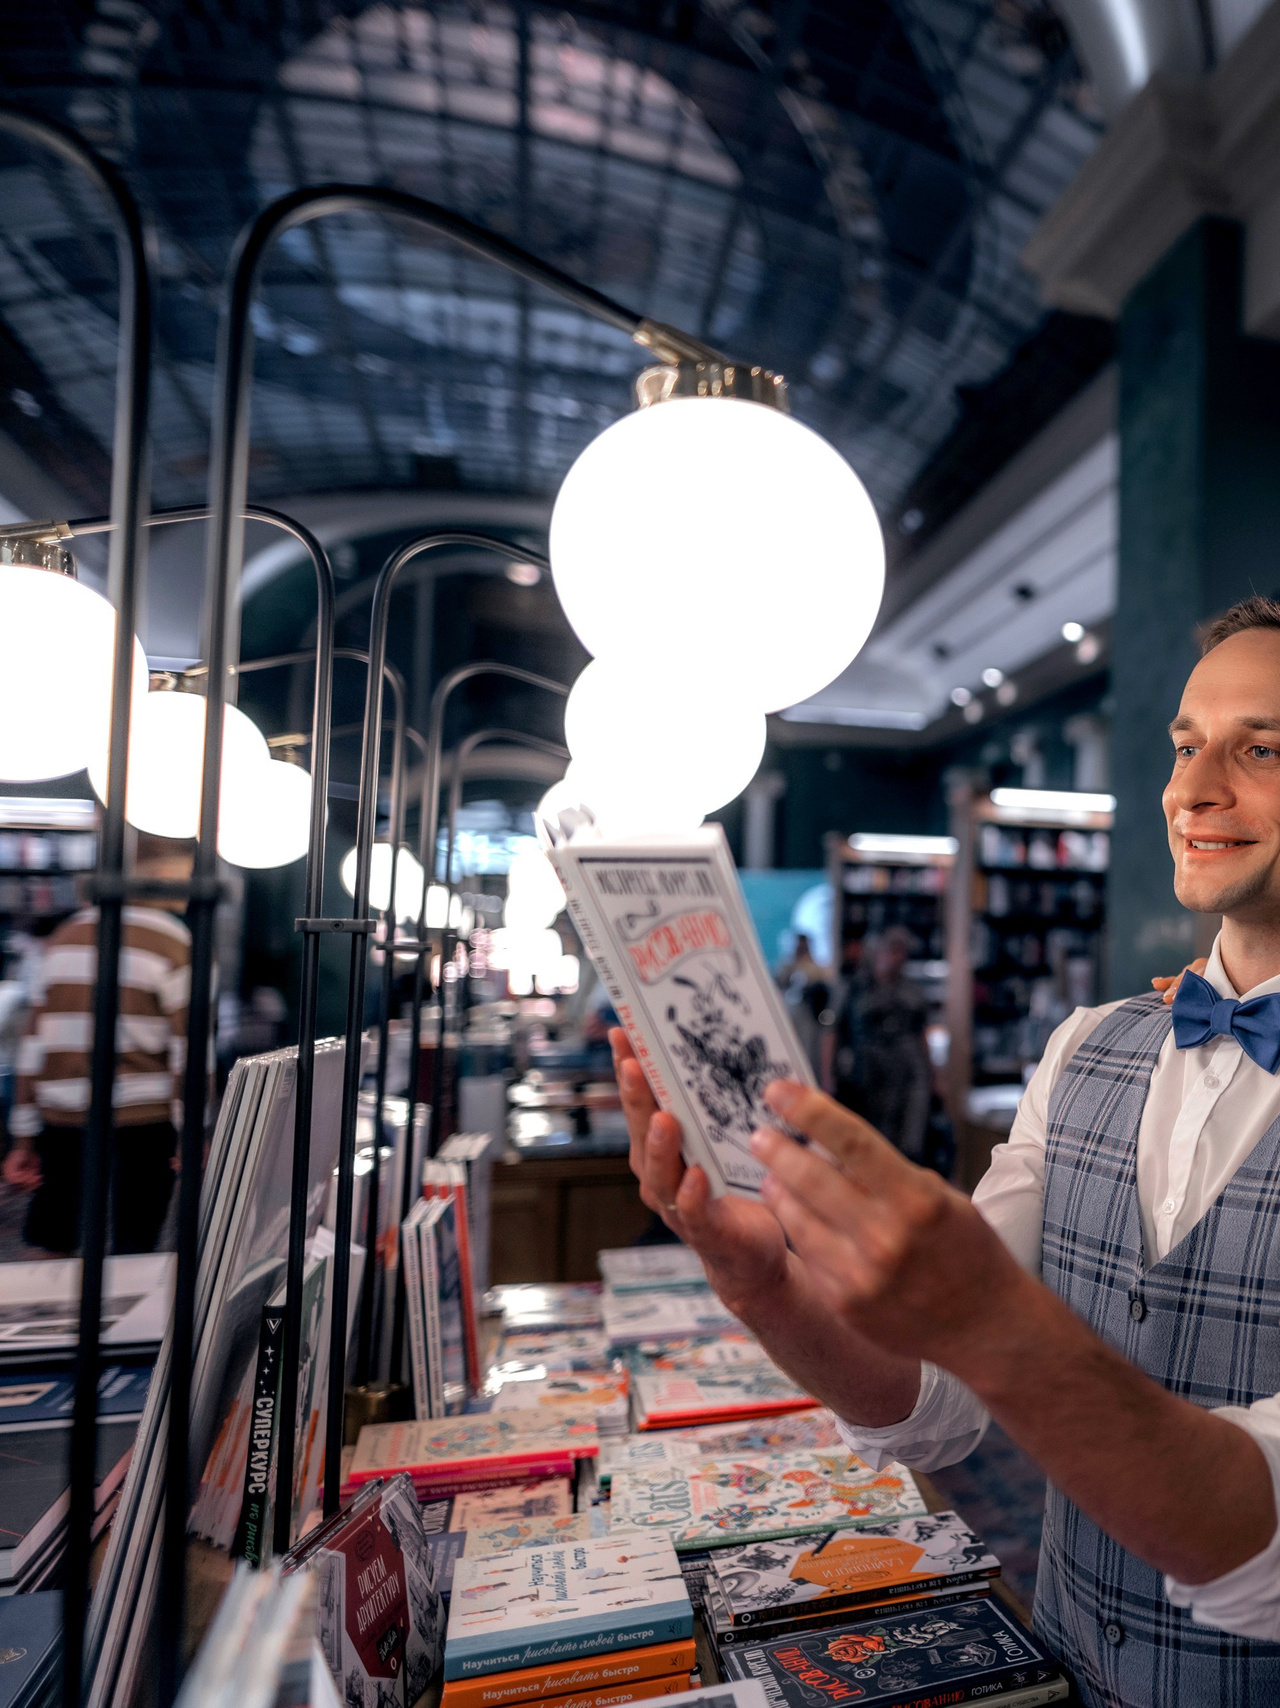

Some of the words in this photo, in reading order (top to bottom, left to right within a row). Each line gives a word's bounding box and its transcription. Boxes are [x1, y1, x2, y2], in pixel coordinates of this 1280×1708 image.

[628, 912, 732, 982] РИСОВАНИЮ
[248, 1397, 274, 1494] СУПЕРКУРС
[631, 1479, 693, 1527] Cats
[244, 1521, 260, 1561] рисов
[571, 1547, 590, 1570] быстро
[356, 1553, 388, 1600] РИСУЕМ
[527, 1553, 544, 1588] Научиться
[355, 1571, 401, 1635] АРХИТЕКТУРУ
[462, 1653, 520, 1671] Научиться
[521, 1641, 577, 1664] рисовать
[575, 1633, 615, 1652] людей
[617, 1628, 655, 1642] быстро
[992, 1630, 1024, 1664] ГОТИКА
[482, 1682, 540, 1701] Научиться
[541, 1671, 600, 1694] рисовать
[602, 1665, 640, 1678] быстро
[773, 1646, 863, 1700] РИСОВАНИЮ
[971, 1682, 1004, 1697] ГОТИКА
[595, 1693, 633, 1706] быстро
